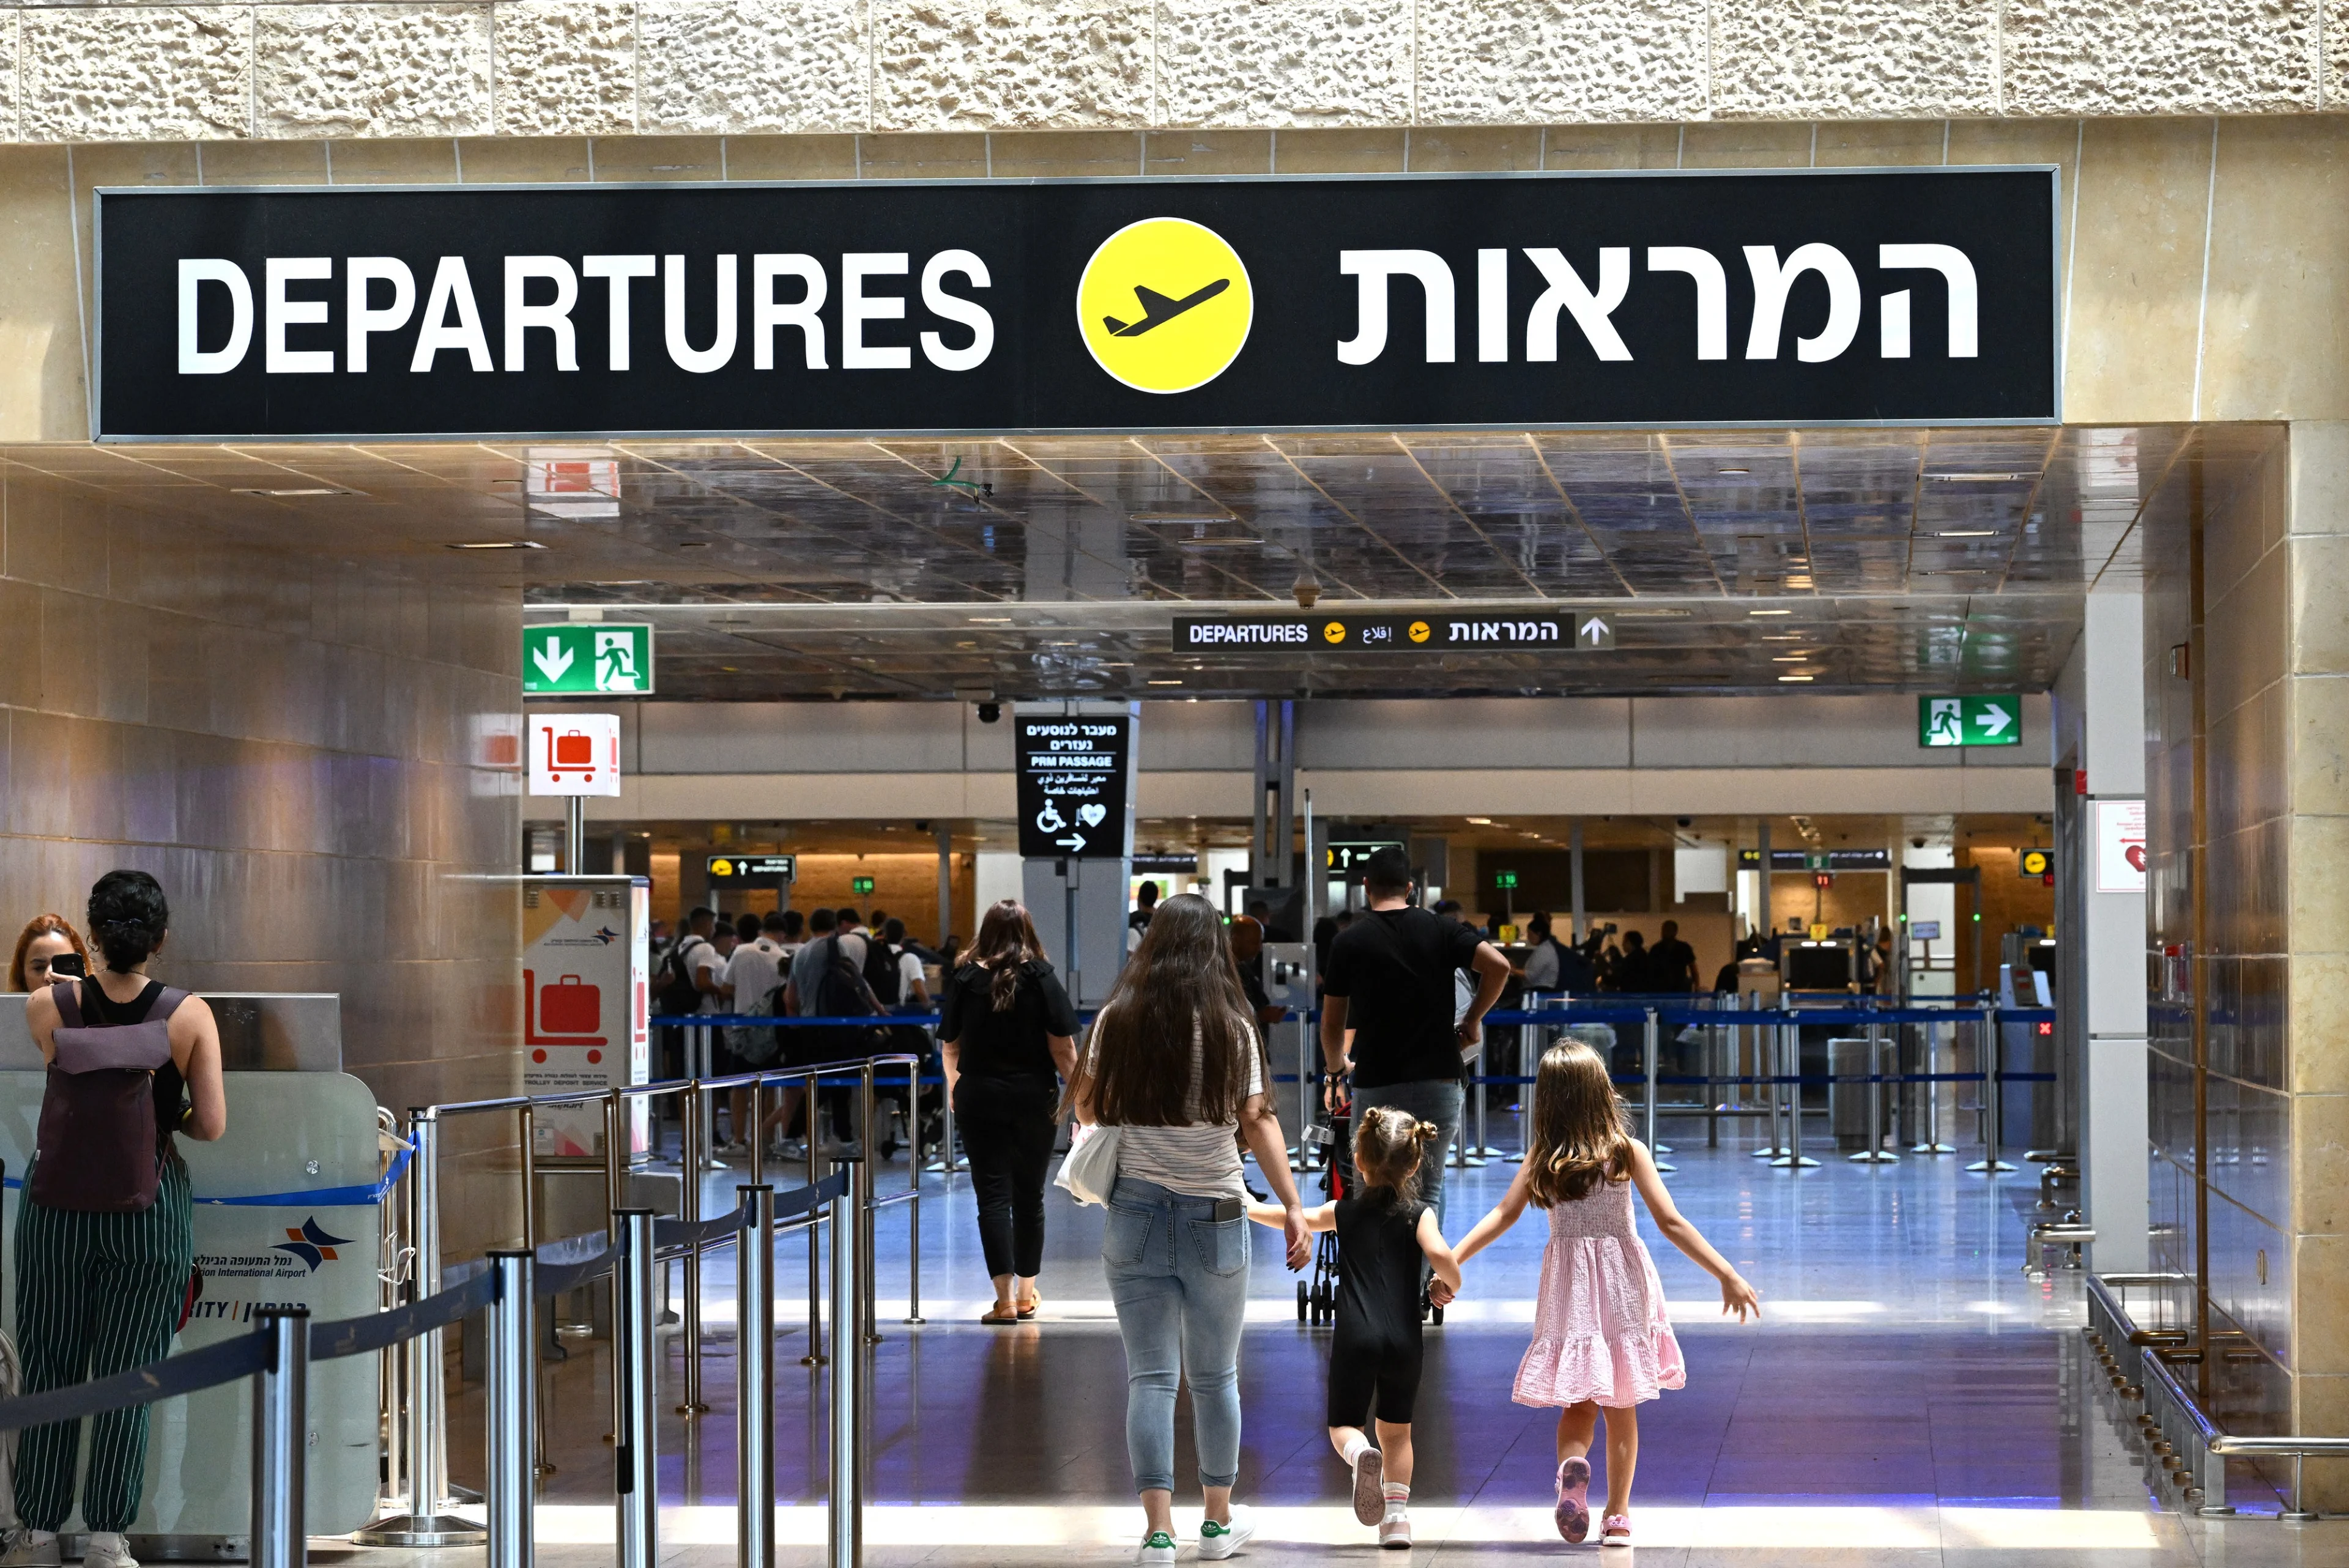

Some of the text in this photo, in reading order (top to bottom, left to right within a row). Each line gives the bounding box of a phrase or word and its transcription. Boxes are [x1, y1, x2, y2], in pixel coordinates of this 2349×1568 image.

[1337, 242, 1978, 365] המראות
[178, 249, 994, 374] DEPARTURES
[1190, 624, 1308, 643] DEPARTURES
[1362, 626, 1392, 644] إقلاع
[1449, 622, 1559, 641] המראות
[1026, 722, 1117, 736] מעבר לנוסעים
[1050, 740, 1093, 751] נעזרים
[1031, 756, 1112, 767] PRM PASSAGE
[229, 1256, 271, 1267] התעופה
[273, 1255, 292, 1266] נמל
[218, 1268, 273, 1278] International
[276, 1268, 306, 1279] Airport
